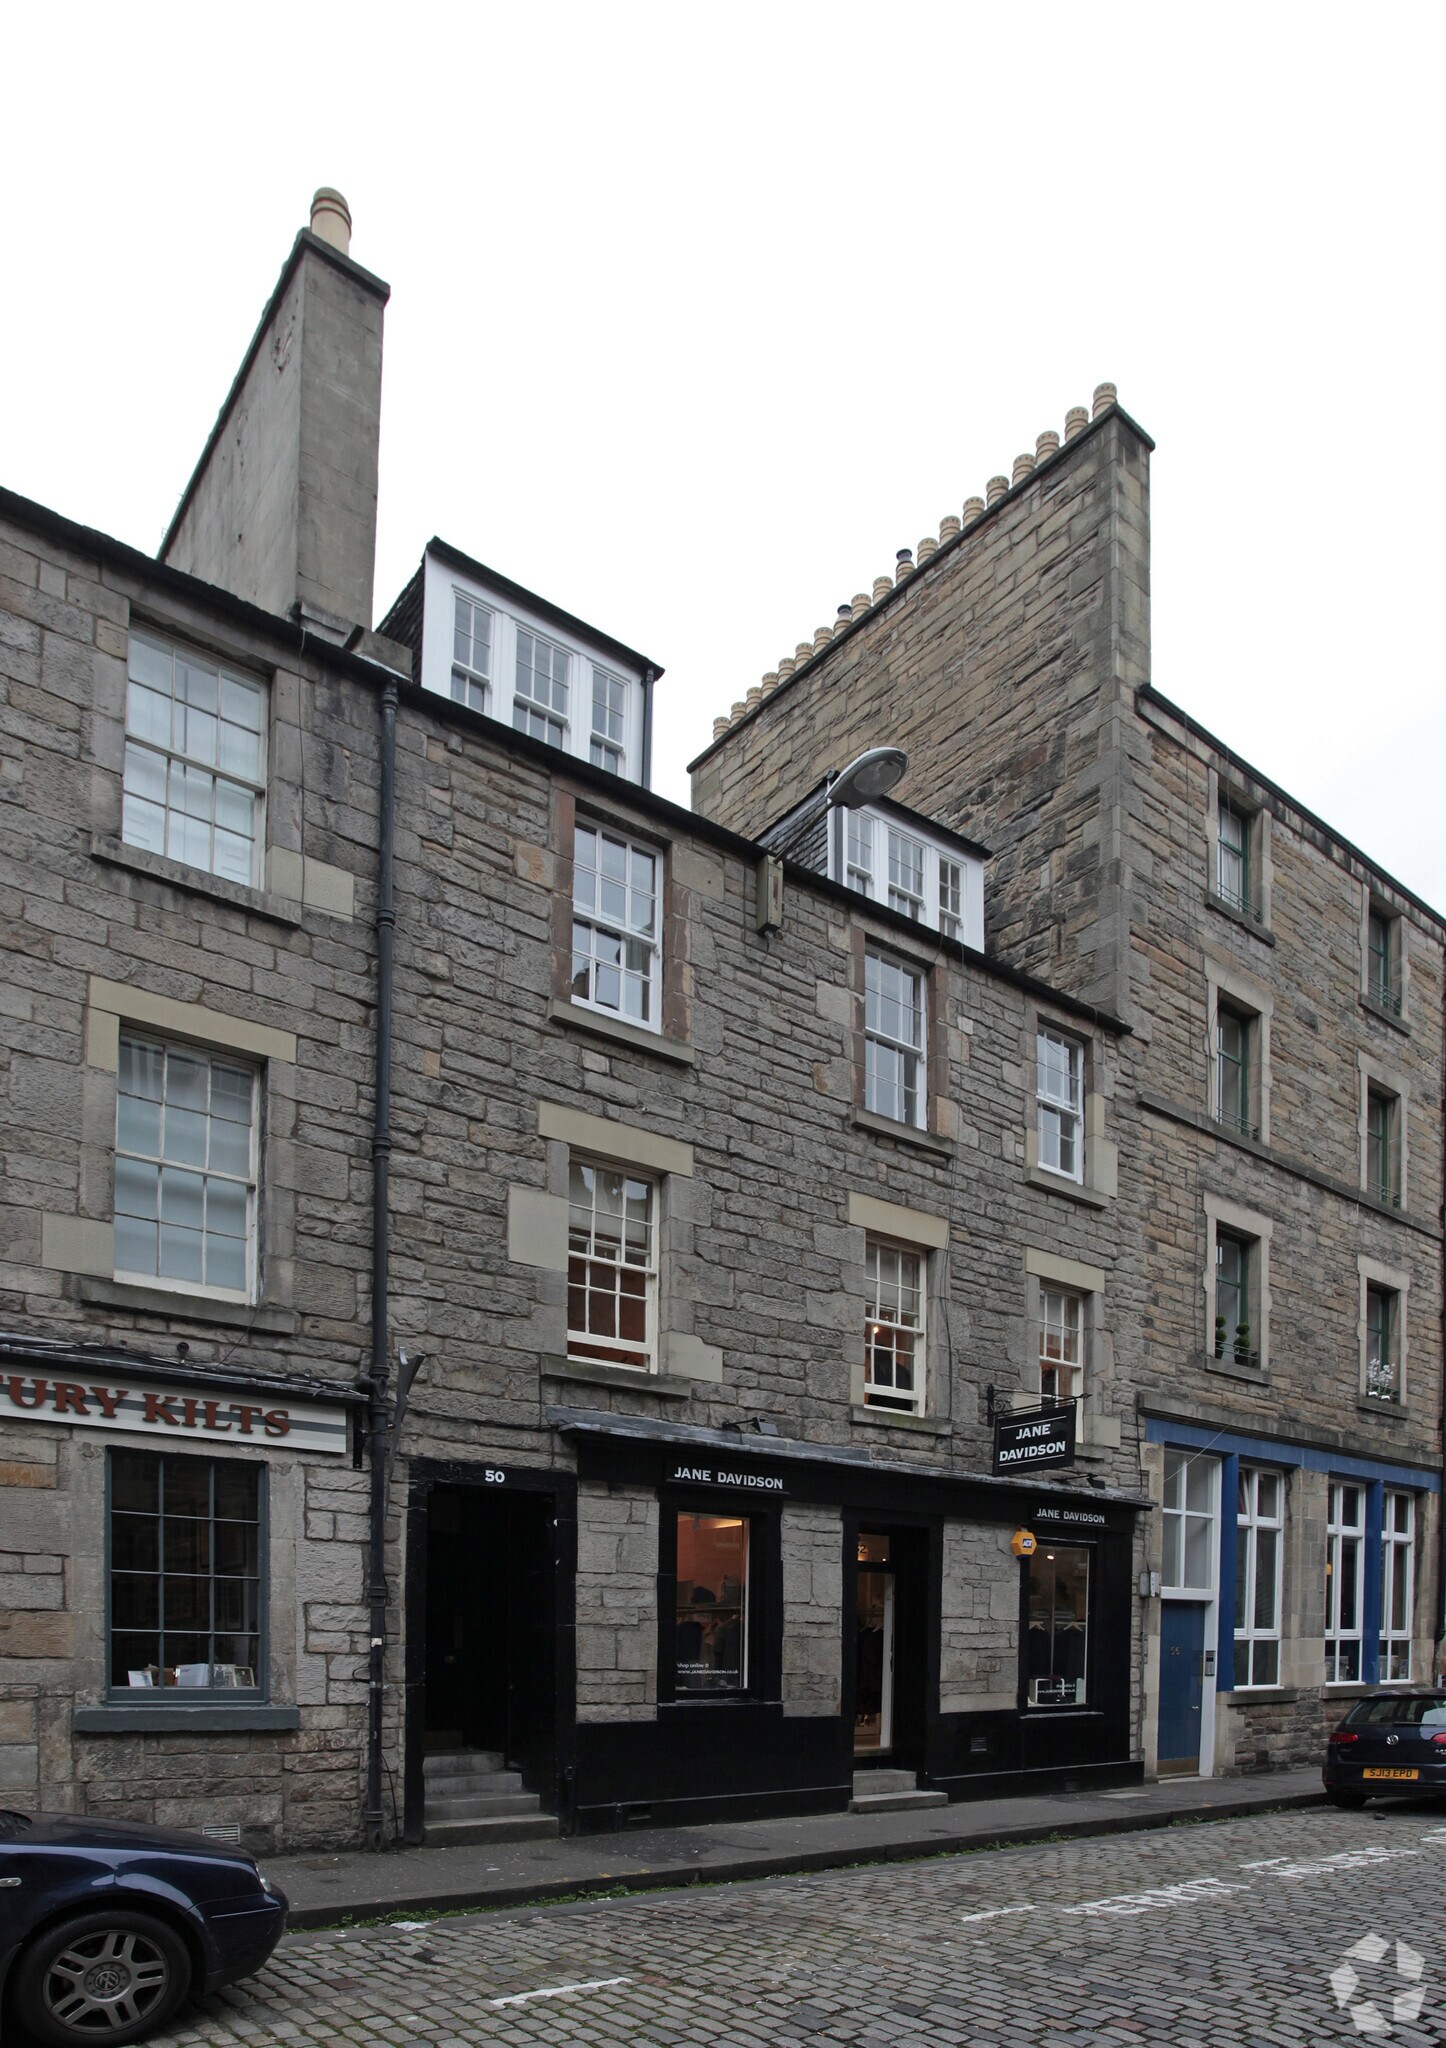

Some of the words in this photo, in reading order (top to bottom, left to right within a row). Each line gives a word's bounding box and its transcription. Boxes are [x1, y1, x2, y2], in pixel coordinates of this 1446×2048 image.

[0, 1375, 129, 1419] URY
[142, 1392, 291, 1438] KILTS
[1015, 1423, 1051, 1440] JANE
[999, 1440, 1066, 1462] DAVIDSON
[484, 1469, 506, 1483] 50
[674, 1466, 712, 1482] JANE
[717, 1471, 783, 1489] DAVIDSON
[1036, 1508, 1060, 1519] JANE
[1063, 1510, 1105, 1523] DAVIDSON
[1369, 1768, 1391, 1777] SJ13
[1393, 1768, 1413, 1778] EPD
[1060, 1877, 1251, 1918] PERMIT
